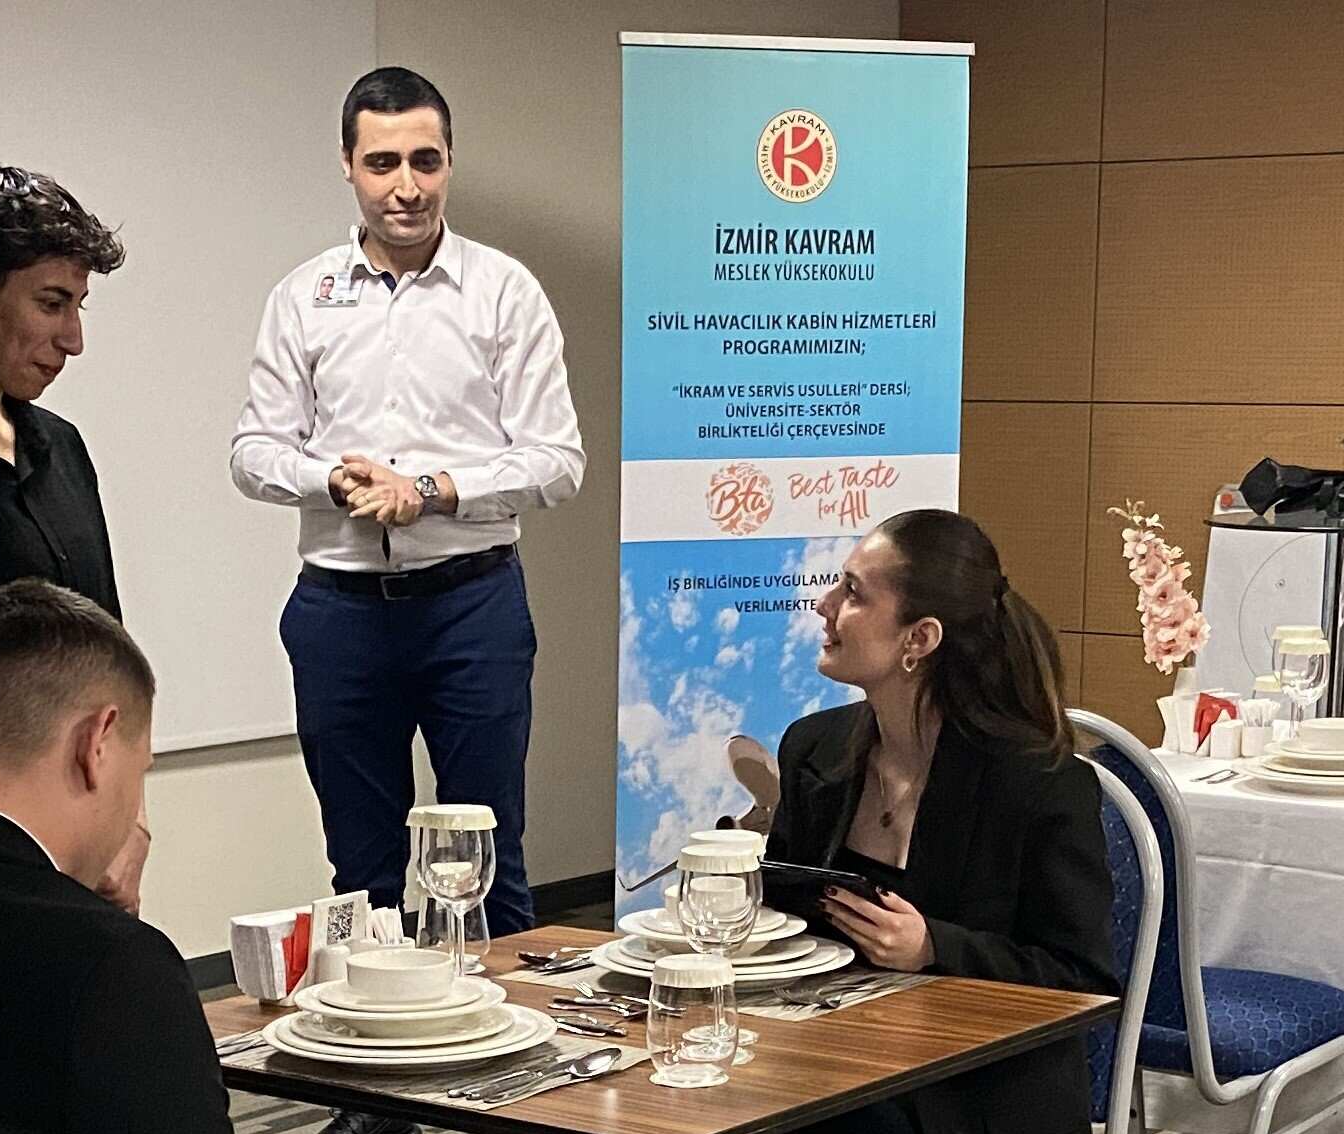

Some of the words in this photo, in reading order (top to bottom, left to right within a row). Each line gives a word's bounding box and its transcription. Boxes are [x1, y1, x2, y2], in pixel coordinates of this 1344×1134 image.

[770, 114, 826, 136] KAVRAM
[761, 144, 774, 180] MESLEK
[771, 178, 825, 199] YÜKSEKOKULU
[715, 223, 778, 255] İZMİR
[785, 229, 875, 255] KAVRAM
[714, 263, 770, 281] MESLEK
[775, 260, 875, 282] YÜKSEKOKULU
[648, 312, 689, 331] SİVİL
[694, 314, 782, 330] HAVACILIK
[786, 312, 838, 330] KABİN
[842, 310, 937, 329] HİZMETLERİ
[722, 339, 866, 356] PROGRAMIMIZIN;
[728, 385, 745, 398] VE
[748, 381, 794, 397] SERVİS
[869, 380, 911, 396] DERSİ;
[725, 402, 861, 418] ÜNİVERSİTE-SEKTÖR
[698, 422, 784, 439] BİRLİKTELİĞİ
[787, 420, 886, 440] ÇERÇEVESİNDE
[787, 470, 835, 500] Best
[838, 459, 901, 489] Taste
[818, 499, 838, 520] for
[839, 490, 871, 529] All
[668, 576, 680, 593] İŞ
[684, 575, 761, 590] BİRLİĞİNDE
[764, 573, 842, 588] UYGULAMA
[735, 599, 816, 613] VERİLMEKTE
